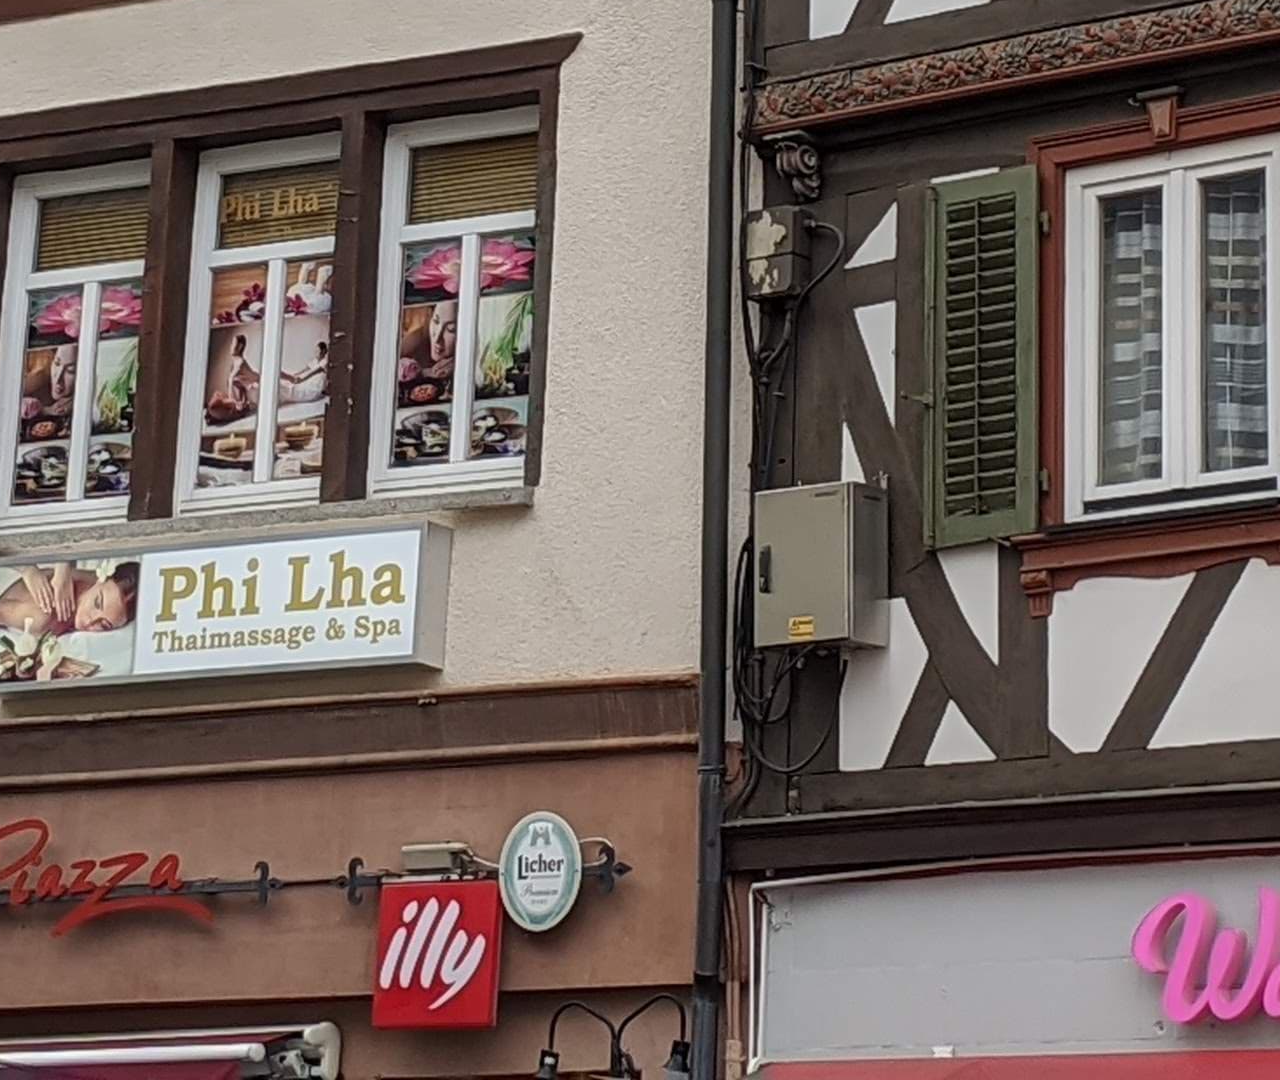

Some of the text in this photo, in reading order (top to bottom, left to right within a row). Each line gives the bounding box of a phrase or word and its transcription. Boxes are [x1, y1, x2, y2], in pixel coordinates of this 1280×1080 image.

[156, 550, 405, 622] Phi Lha
[151, 615, 402, 654] Thaimassage & Spa
[517, 853, 565, 880] Licher
[378, 897, 486, 1010] illy
